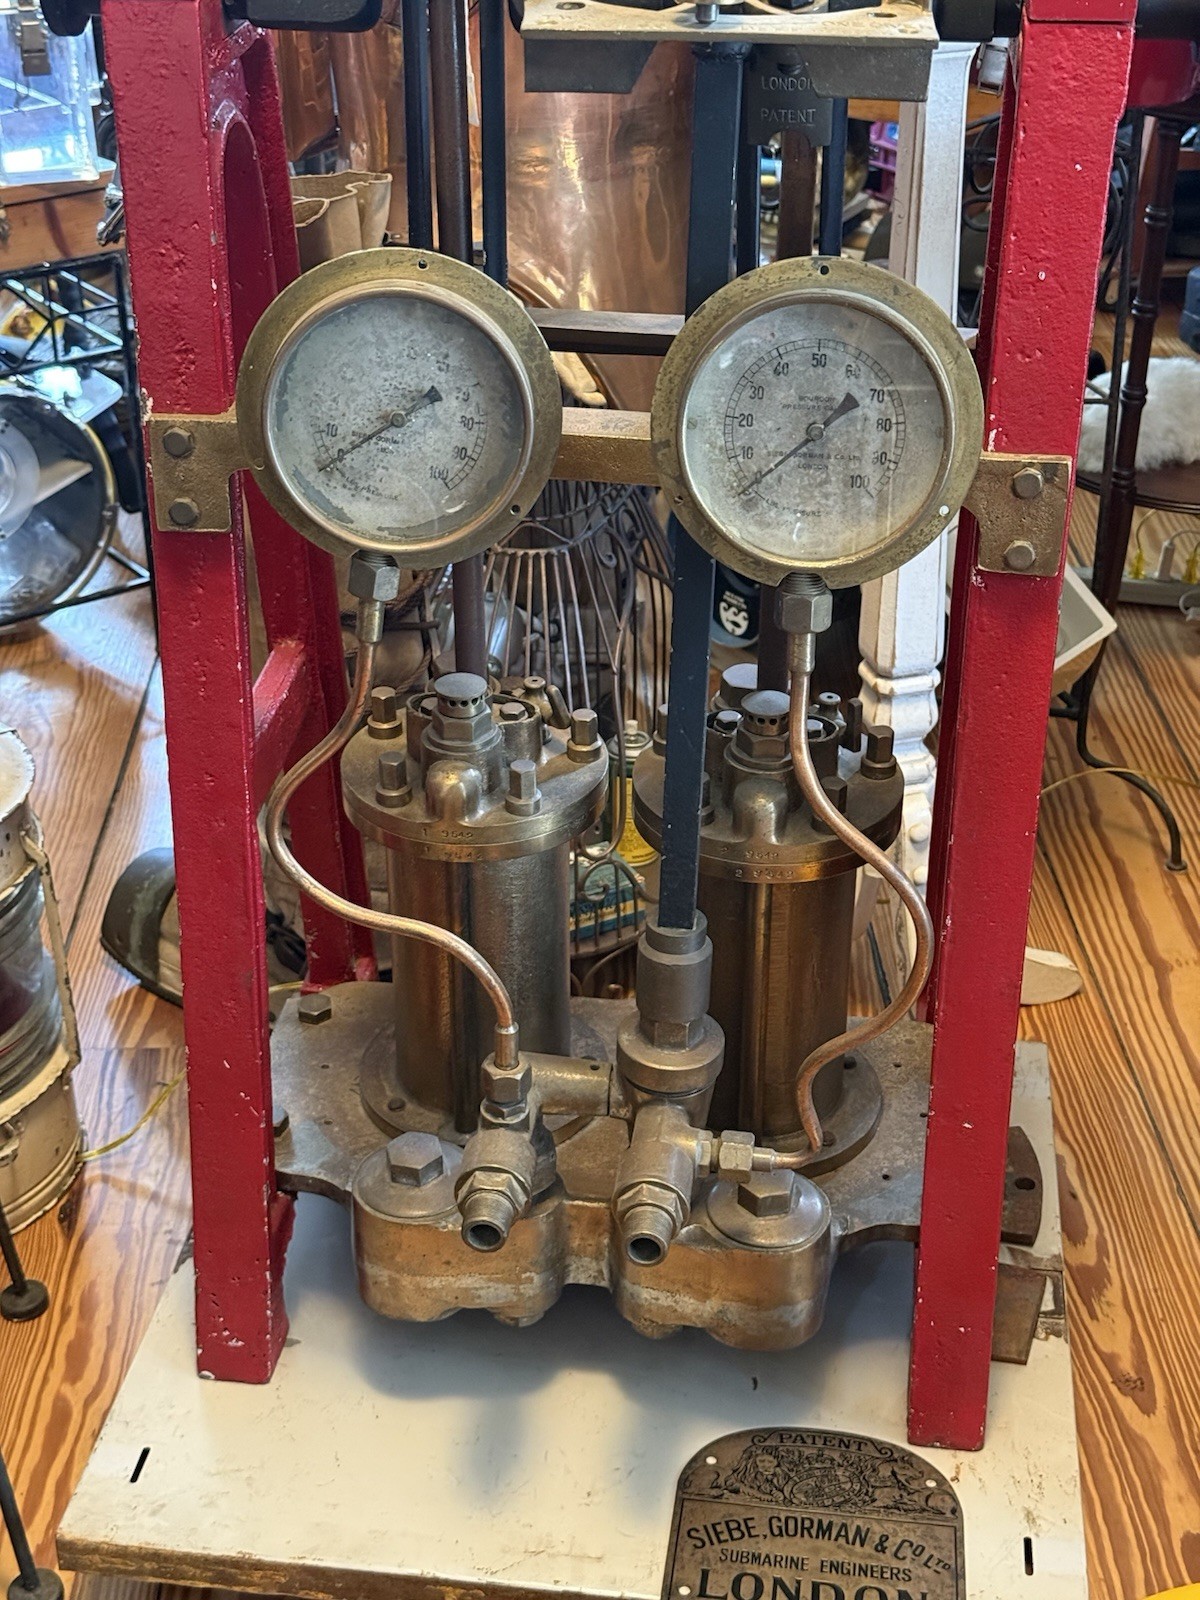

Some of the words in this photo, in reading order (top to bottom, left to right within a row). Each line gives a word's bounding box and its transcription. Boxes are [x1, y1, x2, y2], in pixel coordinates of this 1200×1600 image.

[760, 108, 816, 123] PATENT
[811, 353, 827, 368] 50
[773, 362, 789, 376] 40
[749, 386, 765, 400] 30
[869, 388, 885, 403] 70
[738, 413, 754, 428] 20
[876, 418, 892, 432] 80
[326, 422, 339, 437] 10
[452, 445, 467, 461] 90
[741, 446, 754, 459] 10
[871, 450, 887, 466] 90
[850, 474, 870, 489] 100
[735, 868, 743, 878] 2
[779, 1433, 870, 1452] PATENT
[768, 1515, 870, 1548] GORMAN
[874, 1534, 889, 1554] &
[719, 1548, 810, 1572] SUBMARINE
[820, 1559, 912, 1582] ENGINEERS
